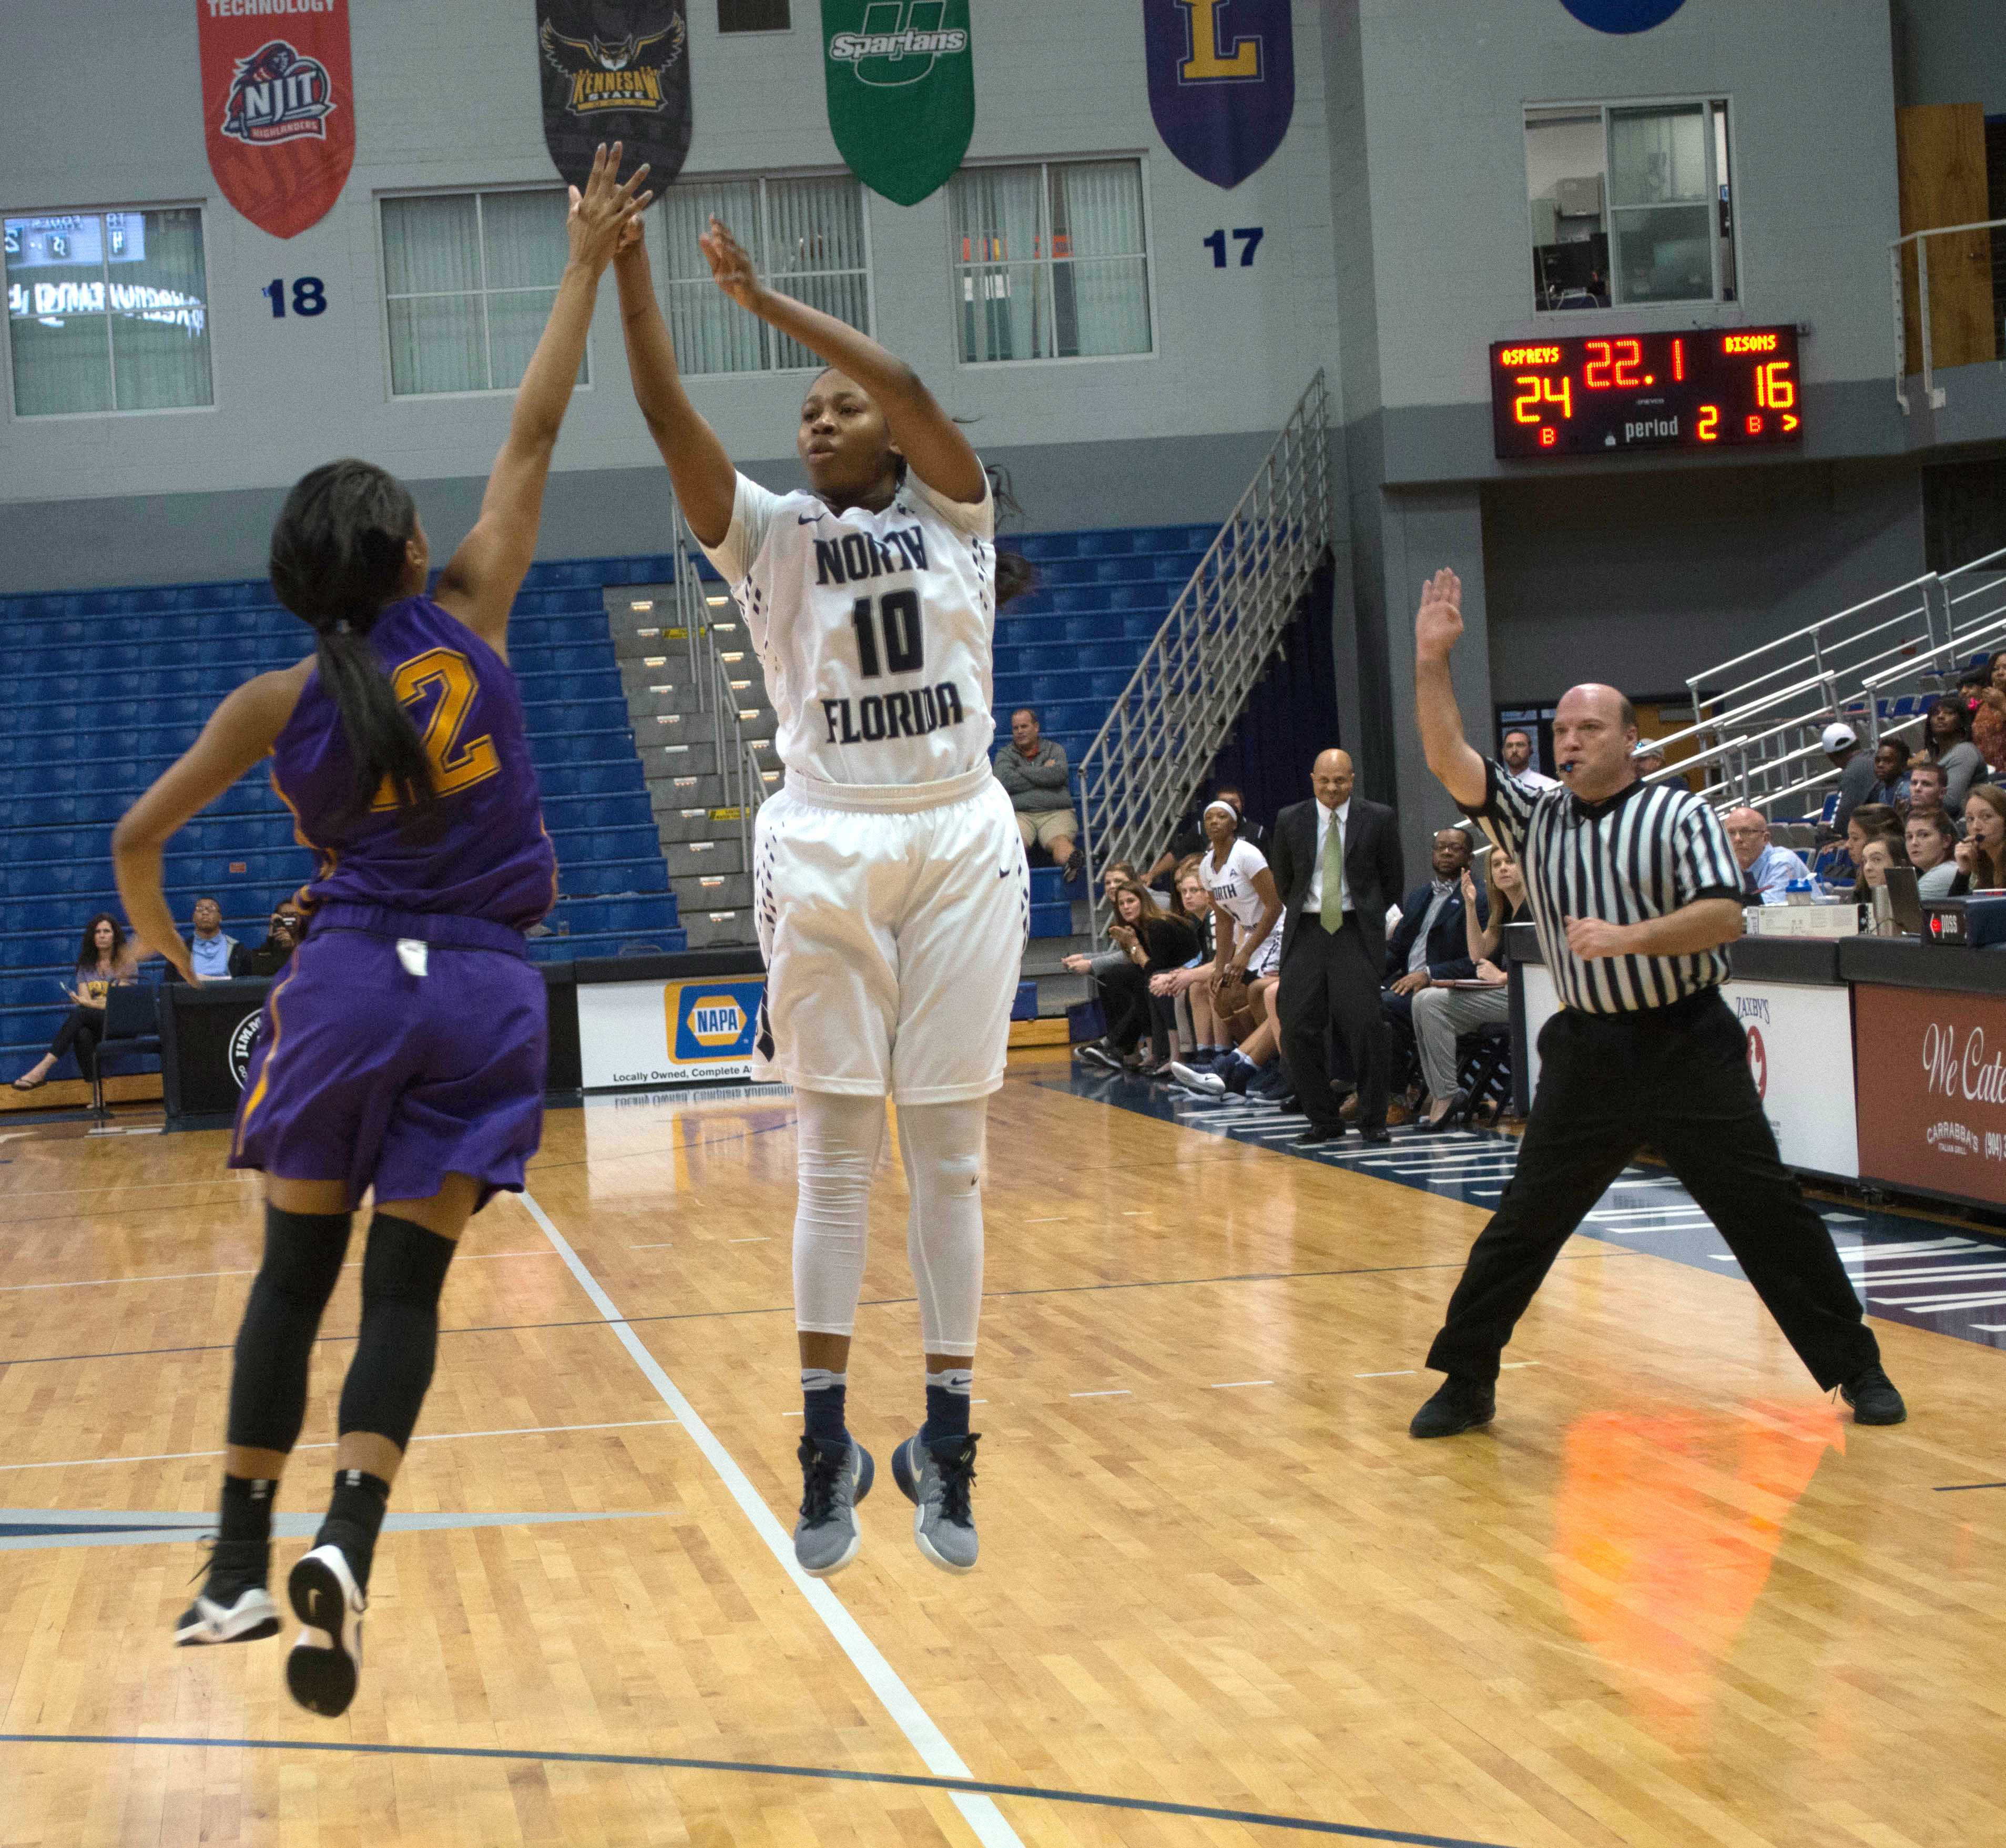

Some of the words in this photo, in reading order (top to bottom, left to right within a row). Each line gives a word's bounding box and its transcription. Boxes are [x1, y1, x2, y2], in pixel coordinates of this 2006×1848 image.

[207, 0, 335, 17] TECHNOLOGY
[832, 29, 965, 59] Spartans
[245, 70, 317, 121] NJIT
[588, 91, 645, 101] STATE
[1204, 227, 1264, 268] 17
[262, 277, 327, 317] 18
[1502, 347, 1559, 365] OSPREYS
[1725, 335, 1776, 353] BISONS
[1516, 375, 1571, 423] 24
[1757, 361, 1794, 409] 16
[1625, 415, 1678, 443] period
[1699, 405, 1718, 440] 2
[852, 587, 924, 679] 10
[821, 681, 964, 745] FLORIDA
[697, 1008, 738, 1033] NAPA
[1736, 997, 1770, 1024] ZAXBY'S
[235, 1016, 262, 1059] JIMM
[613, 1071, 648, 1082] Locally
[651, 1069, 689, 1079] Owned,
[691, 1065, 740, 1078] Complete
[1923, 1023, 1958, 1096] We
[1927, 1121, 1979, 1153] CARRABBA'S
